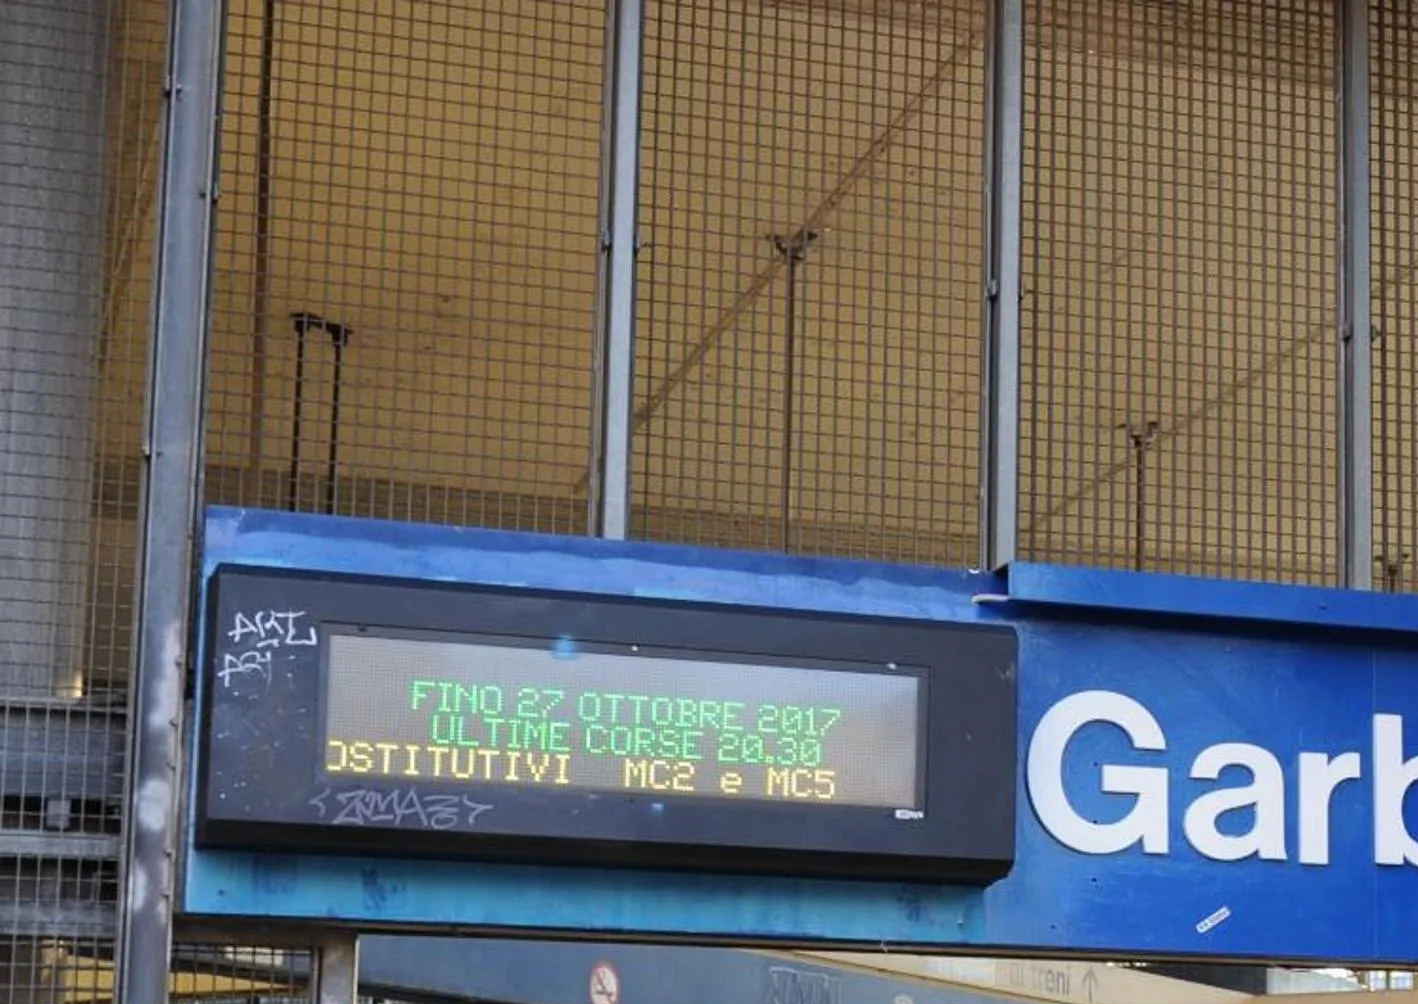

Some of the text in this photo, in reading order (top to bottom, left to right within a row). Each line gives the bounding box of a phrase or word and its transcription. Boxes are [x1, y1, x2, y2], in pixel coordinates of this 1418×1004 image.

[409, 681, 843, 736] FINO 27 OTTOBRE 2017
[431, 714, 823, 767] ULTIME CORSE 20.30
[623, 760, 696, 792] MC2
[720, 771, 743, 797] e
[767, 768, 837, 800] MC5
